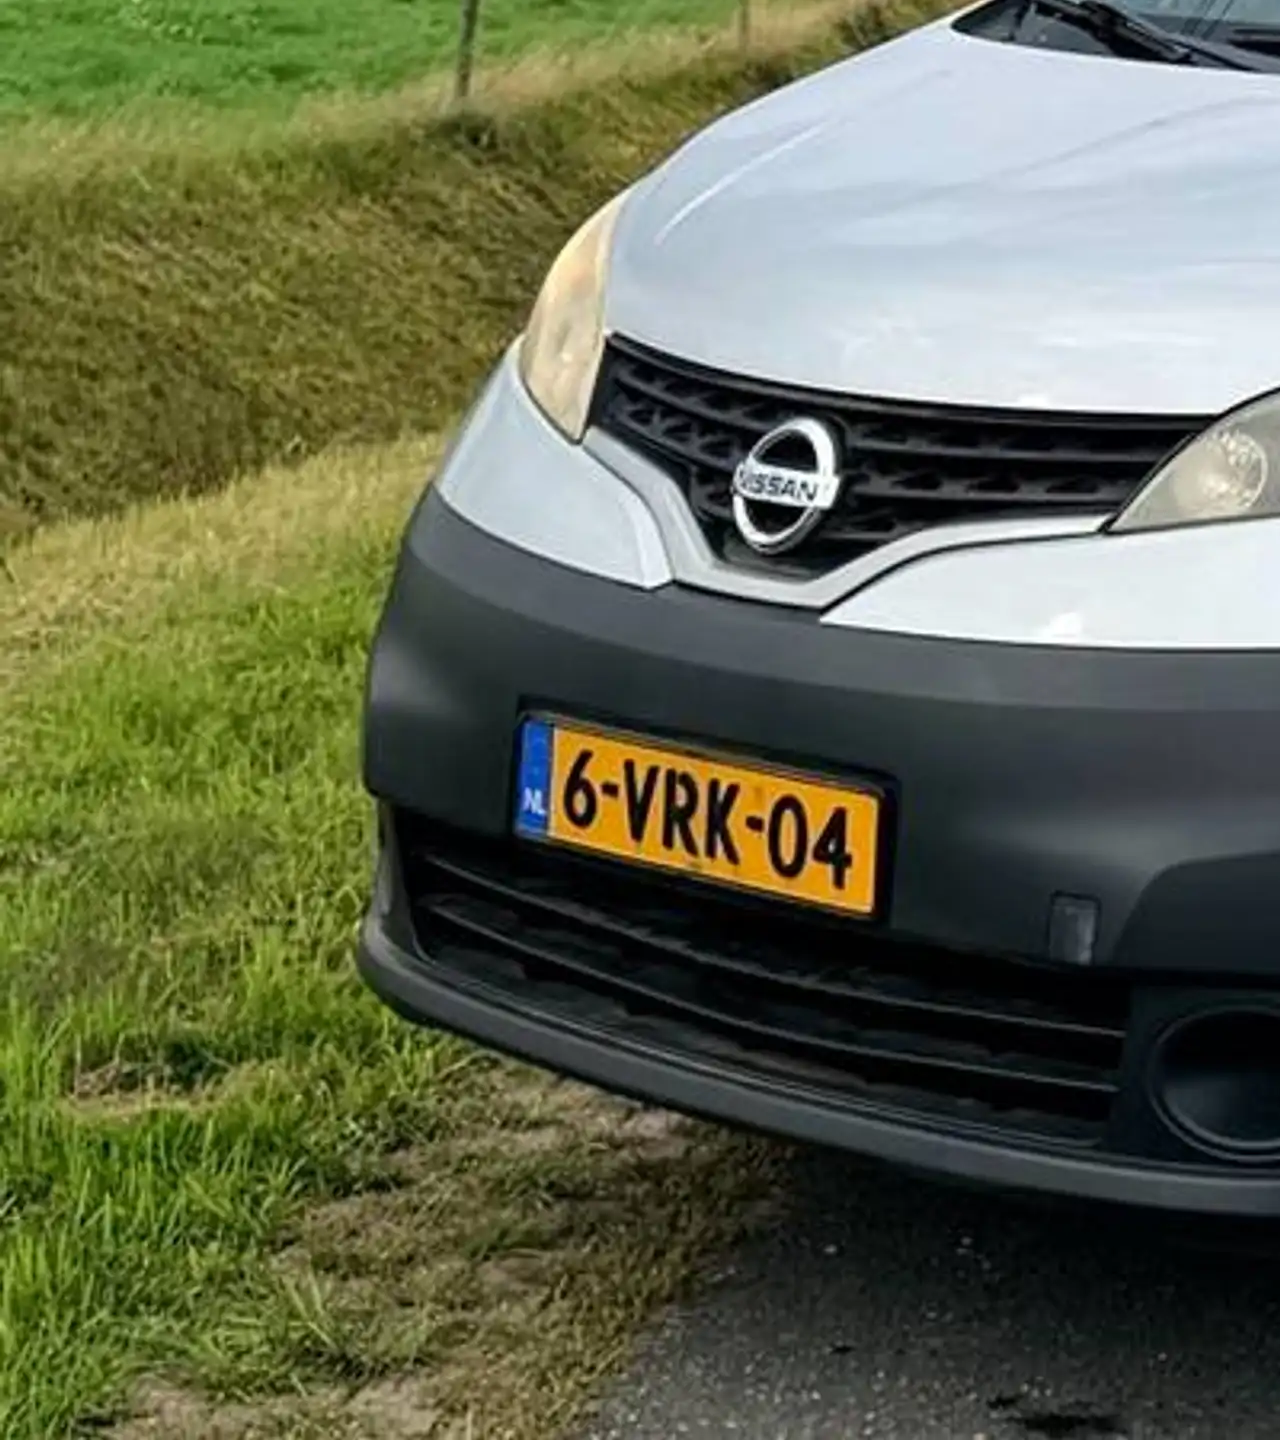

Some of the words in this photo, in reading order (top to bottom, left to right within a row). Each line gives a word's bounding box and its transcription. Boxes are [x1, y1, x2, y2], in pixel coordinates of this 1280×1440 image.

[737, 466, 820, 502] NISSAN
[523, 786, 546, 816] NL
[562, 748, 853, 890] 6-VRK-04
